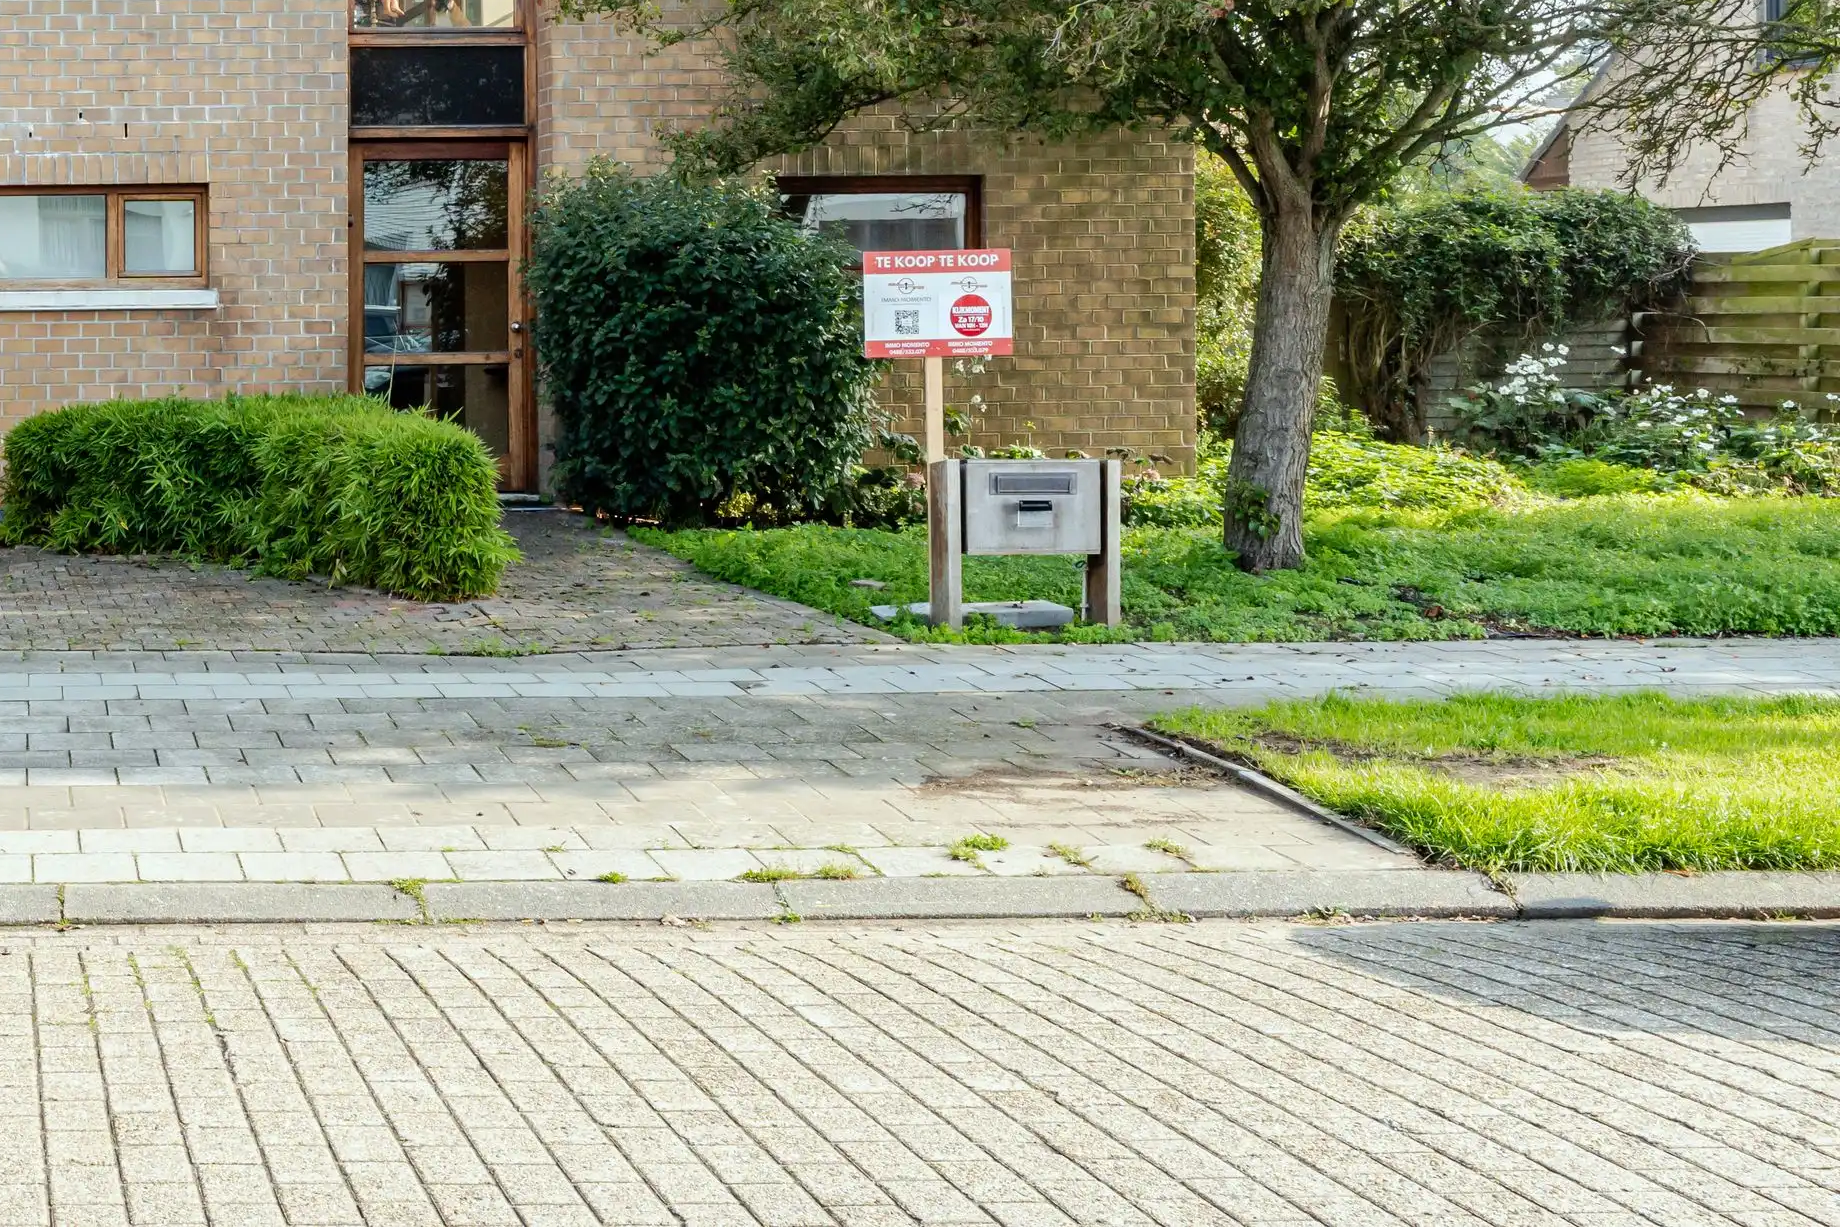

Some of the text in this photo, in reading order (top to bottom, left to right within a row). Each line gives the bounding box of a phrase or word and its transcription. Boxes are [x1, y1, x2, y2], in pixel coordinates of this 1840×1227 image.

[876, 256, 935, 268] TE KOOP
[939, 254, 999, 267] TE KOOP
